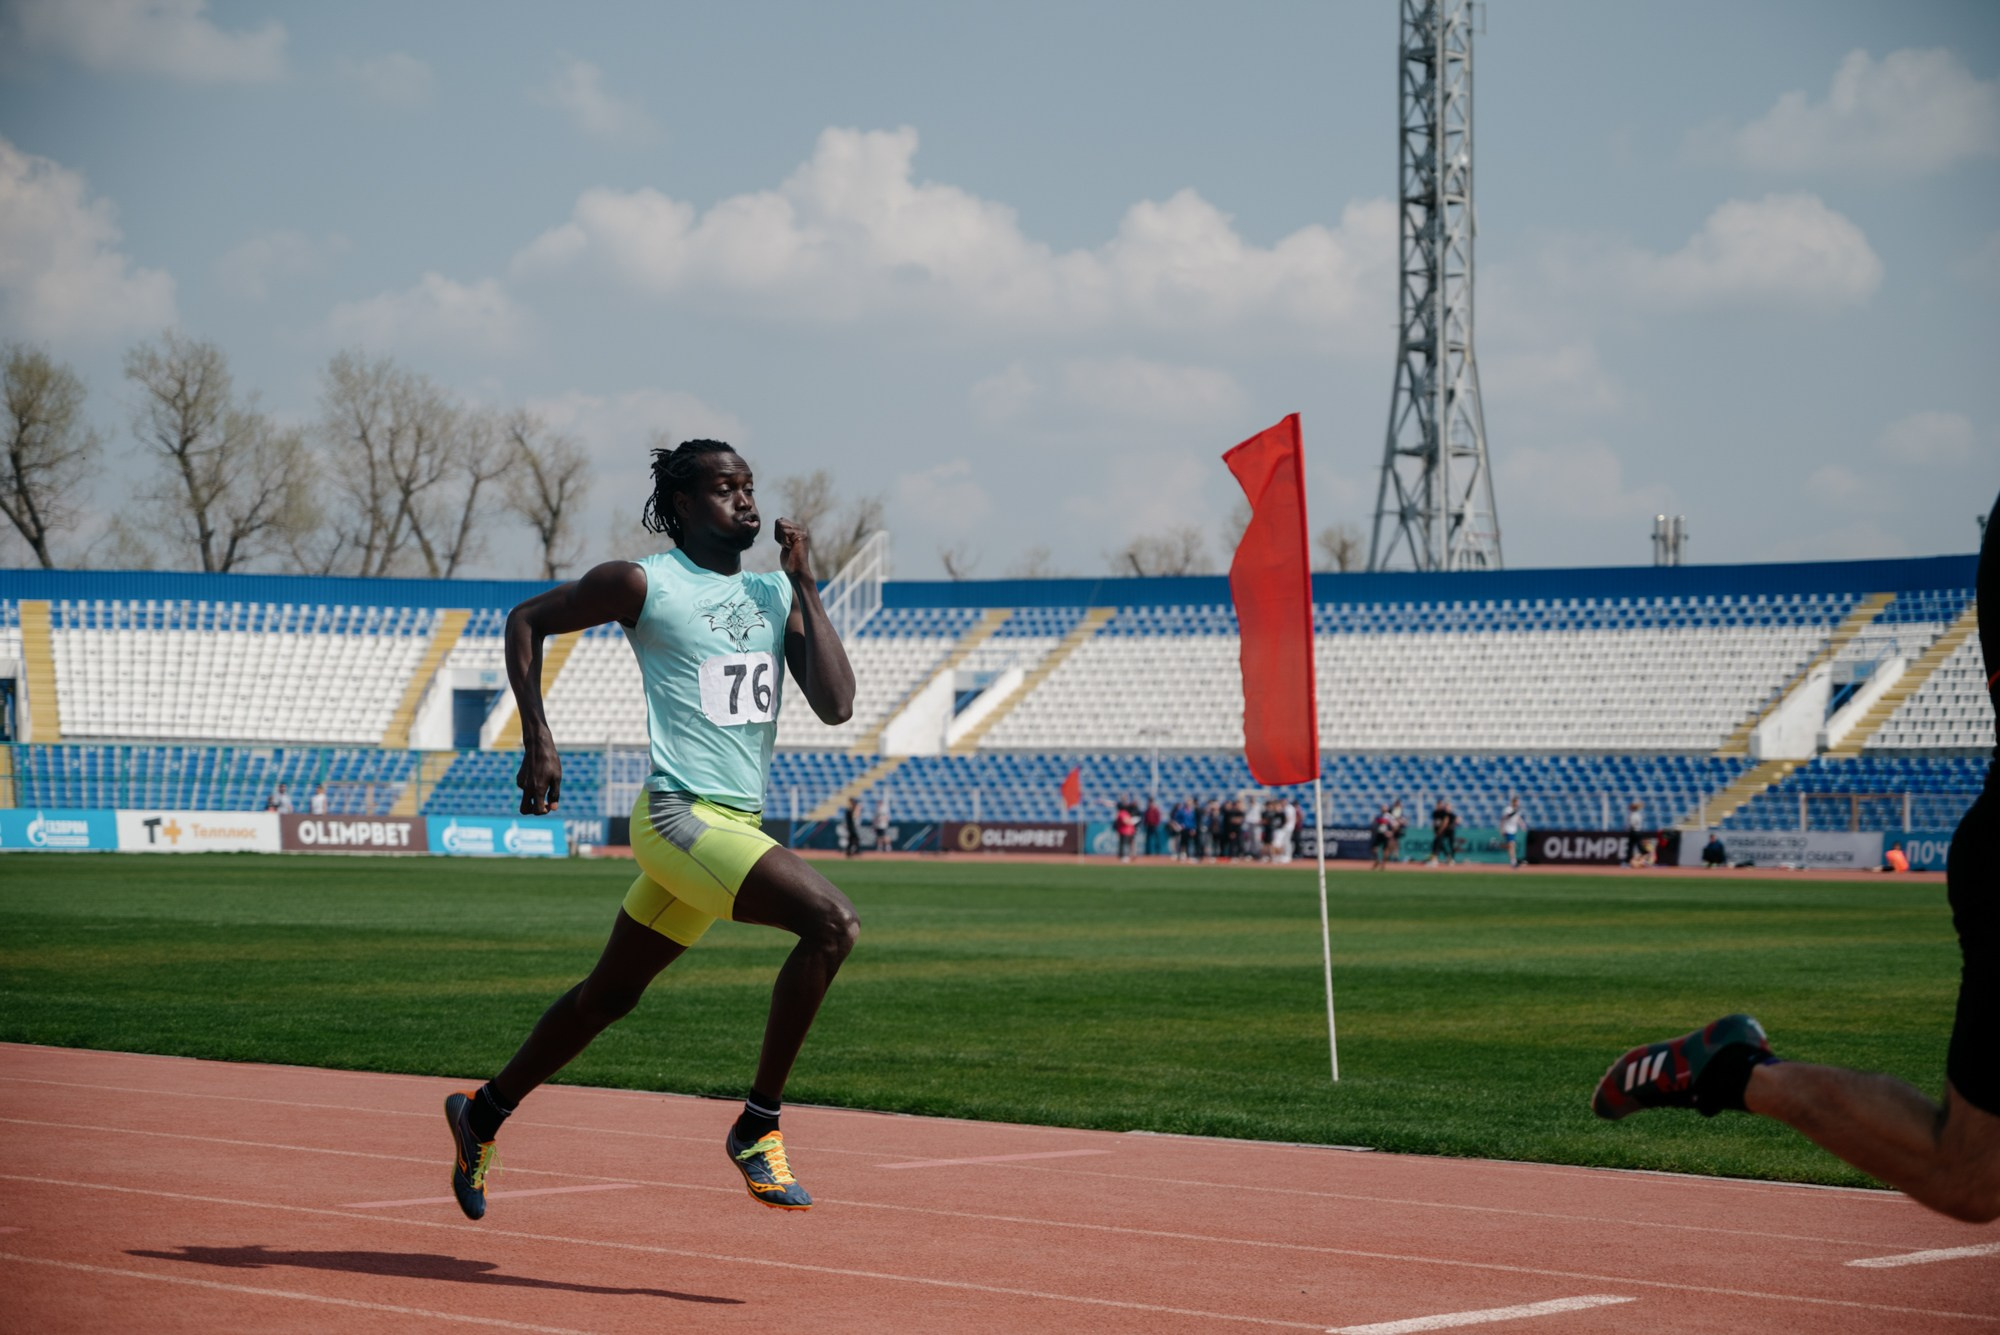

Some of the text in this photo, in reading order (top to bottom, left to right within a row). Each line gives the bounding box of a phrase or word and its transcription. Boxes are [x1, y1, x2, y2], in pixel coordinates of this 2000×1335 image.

[723, 663, 771, 715] 76
[298, 820, 411, 846] OLIMPBET
[982, 828, 1067, 848] OLIMPBET
